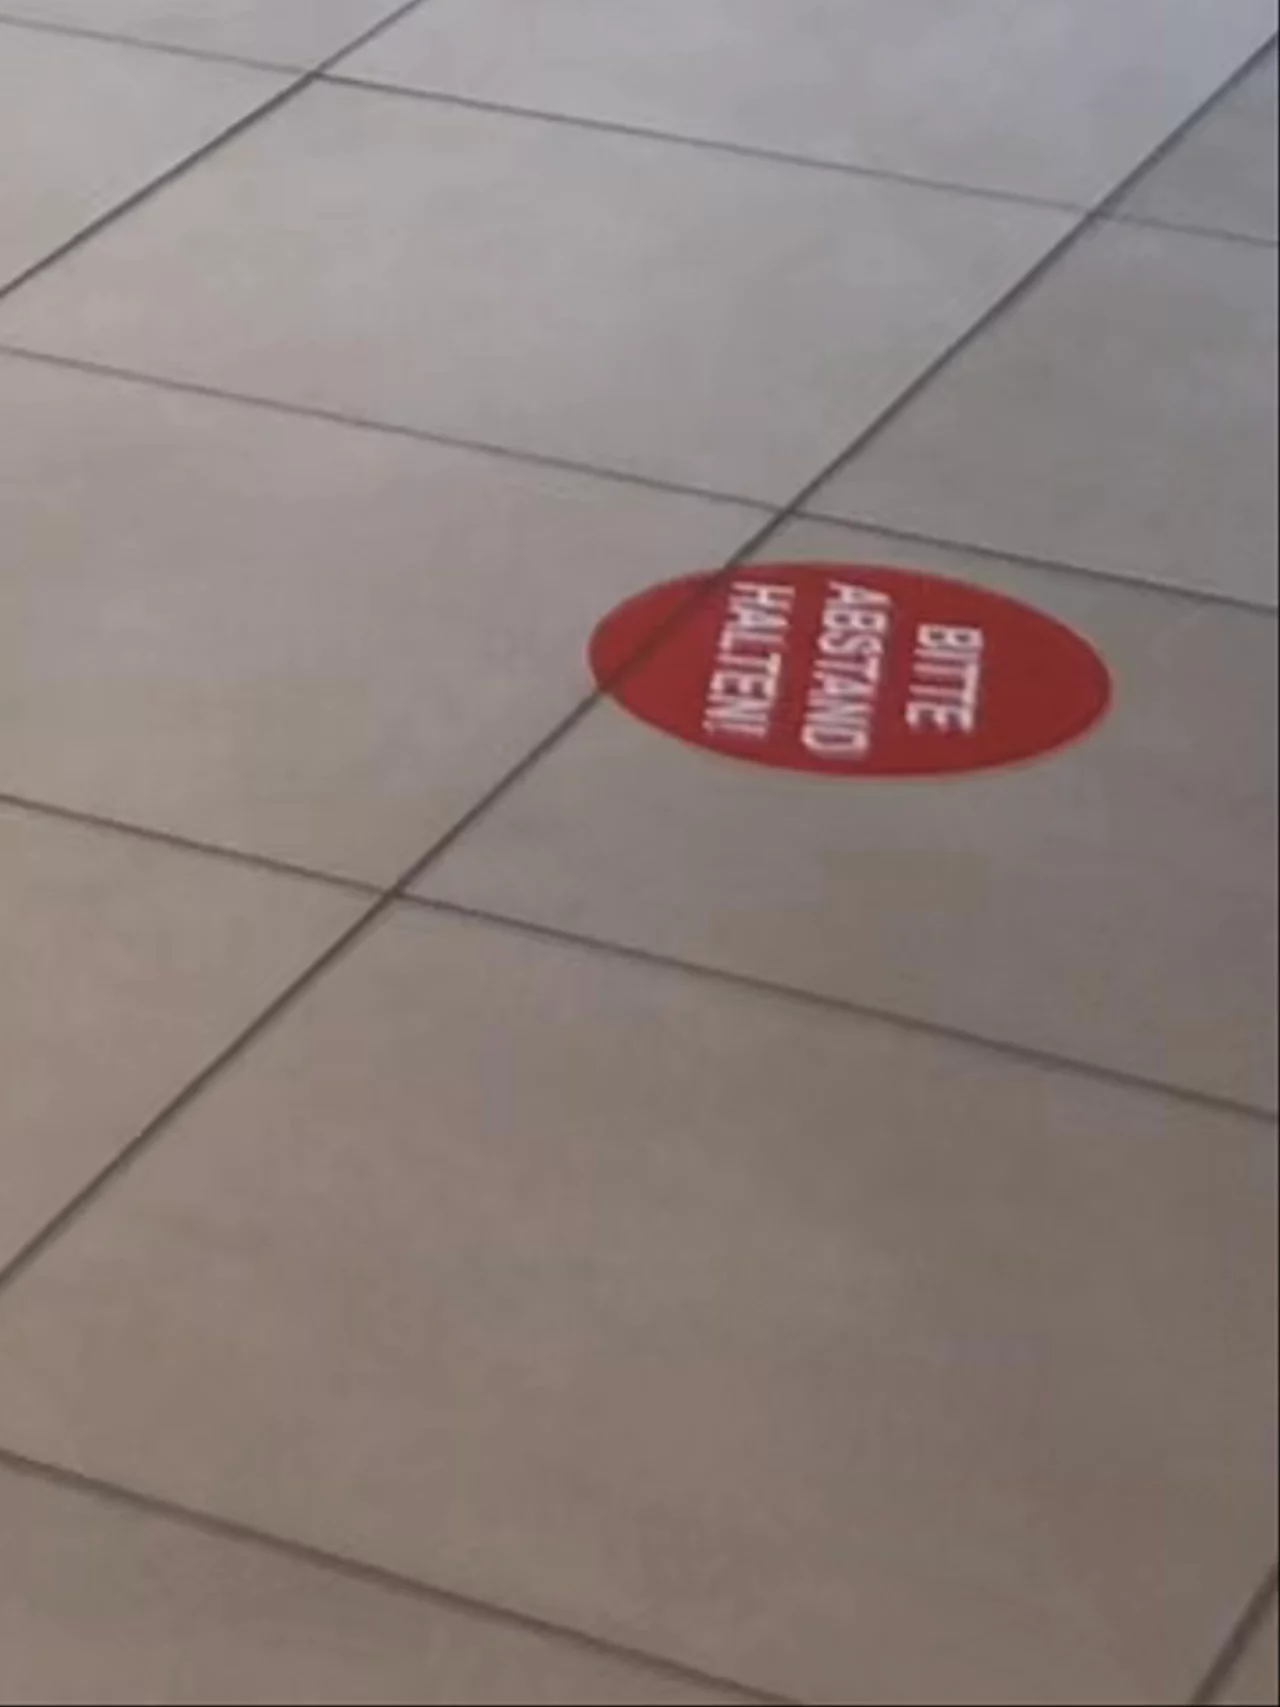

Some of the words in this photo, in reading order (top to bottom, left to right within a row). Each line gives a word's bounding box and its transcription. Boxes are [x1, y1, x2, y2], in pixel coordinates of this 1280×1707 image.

[701, 581, 796, 740] HALTEN!
[801, 579, 894, 760] ABSTAND
[904, 623, 984, 734] BITTE
